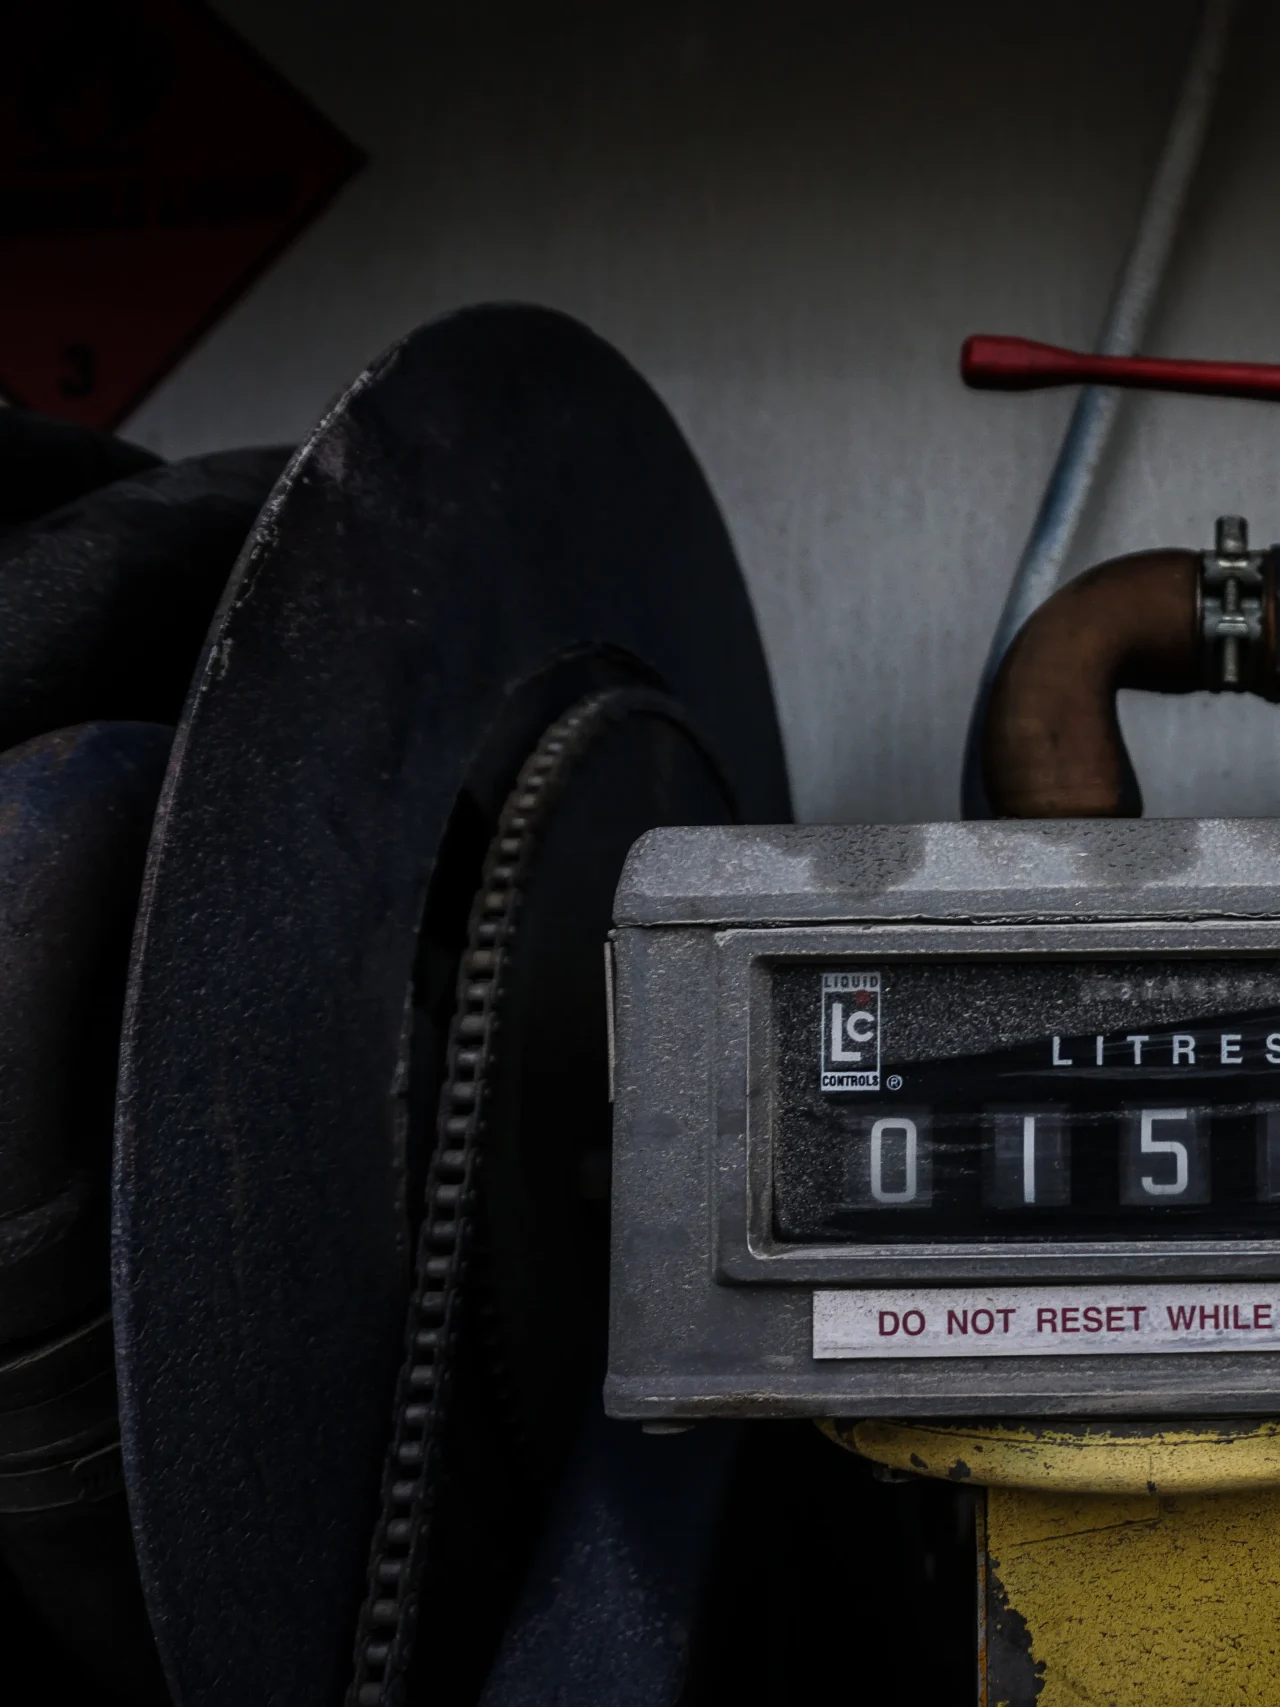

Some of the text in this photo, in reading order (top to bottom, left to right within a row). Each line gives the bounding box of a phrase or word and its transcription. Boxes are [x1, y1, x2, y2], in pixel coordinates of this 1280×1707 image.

[59, 343, 94, 396] 3
[823, 975, 879, 988] LIQUID
[822, 1075, 879, 1087] CONTROLS
[878, 1310, 926, 1336] DO
[947, 1308, 1016, 1335] NOT
[1036, 1306, 1147, 1333] RESET
[1166, 1304, 1273, 1331] WHILE
